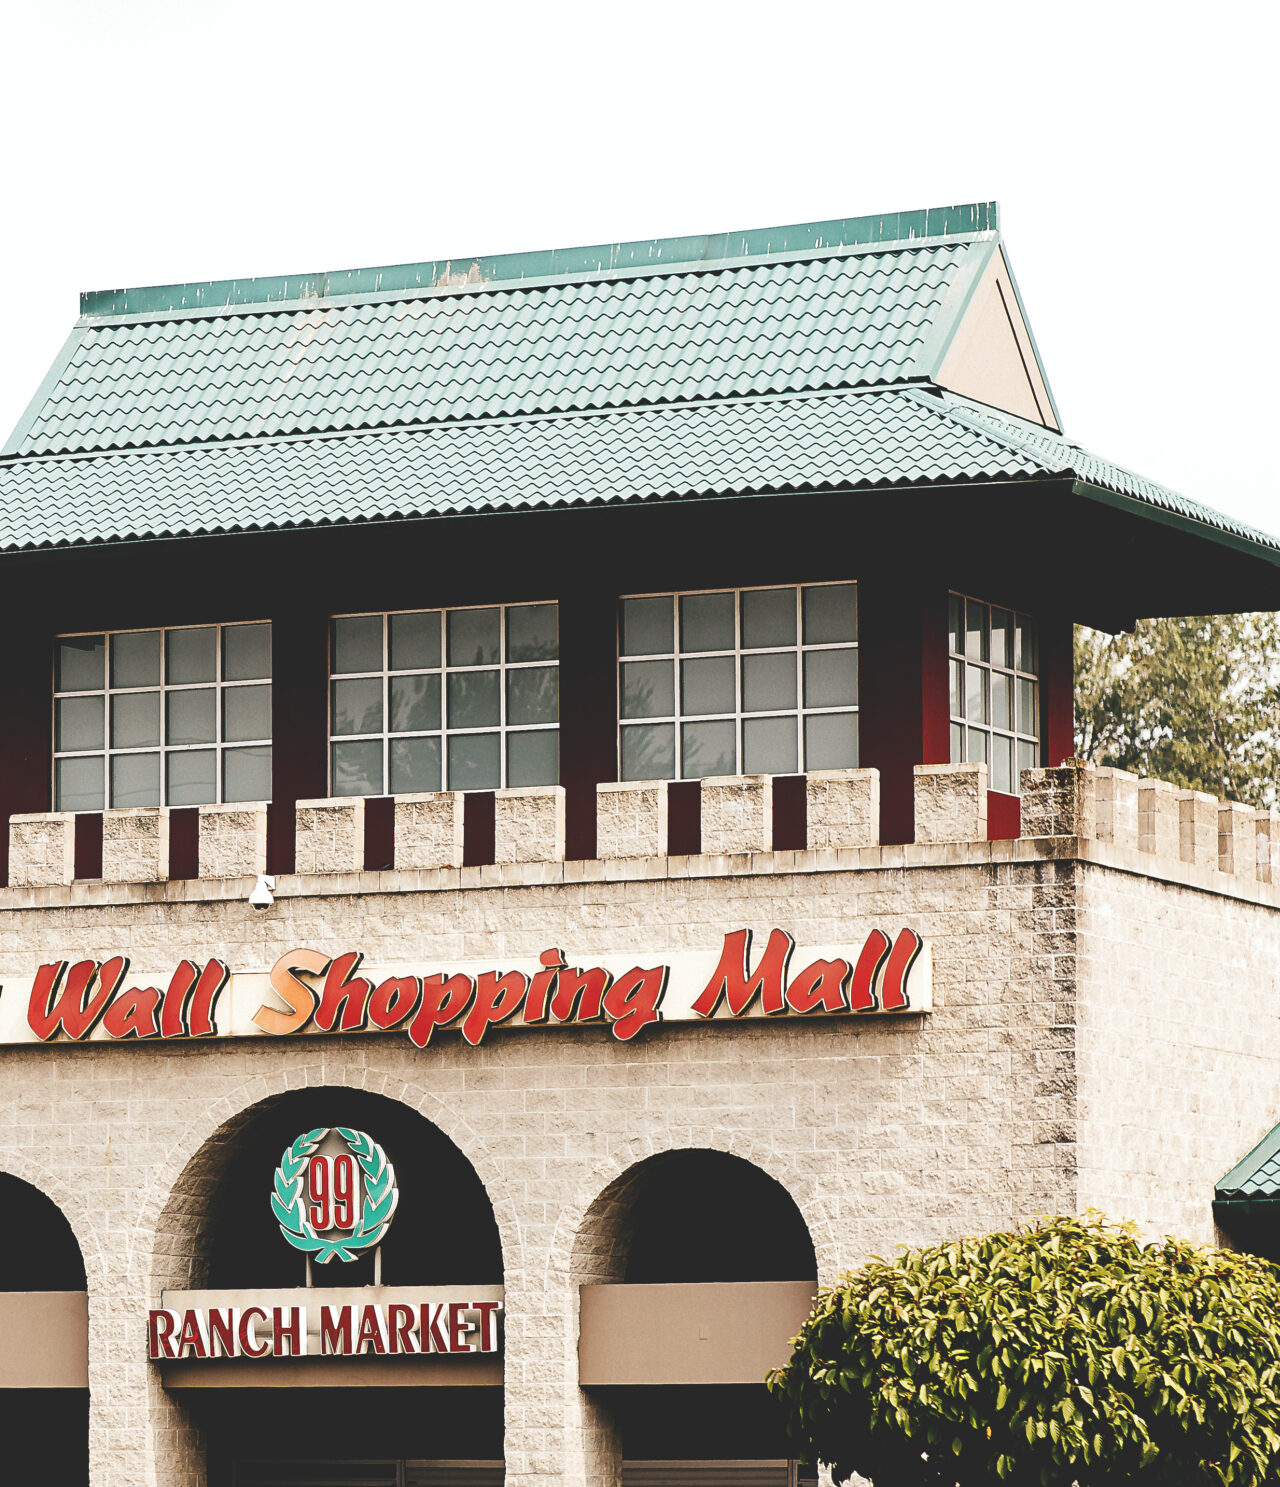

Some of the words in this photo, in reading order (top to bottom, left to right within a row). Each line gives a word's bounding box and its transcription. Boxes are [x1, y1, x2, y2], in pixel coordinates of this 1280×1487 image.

[26, 955, 229, 1041] Wall
[251, 947, 669, 1048] Shopping
[690, 927, 923, 1017] Mall
[309, 1154, 358, 1230] 99
[149, 1306, 301, 1359] RANCH
[319, 1300, 503, 1355] MARKET
